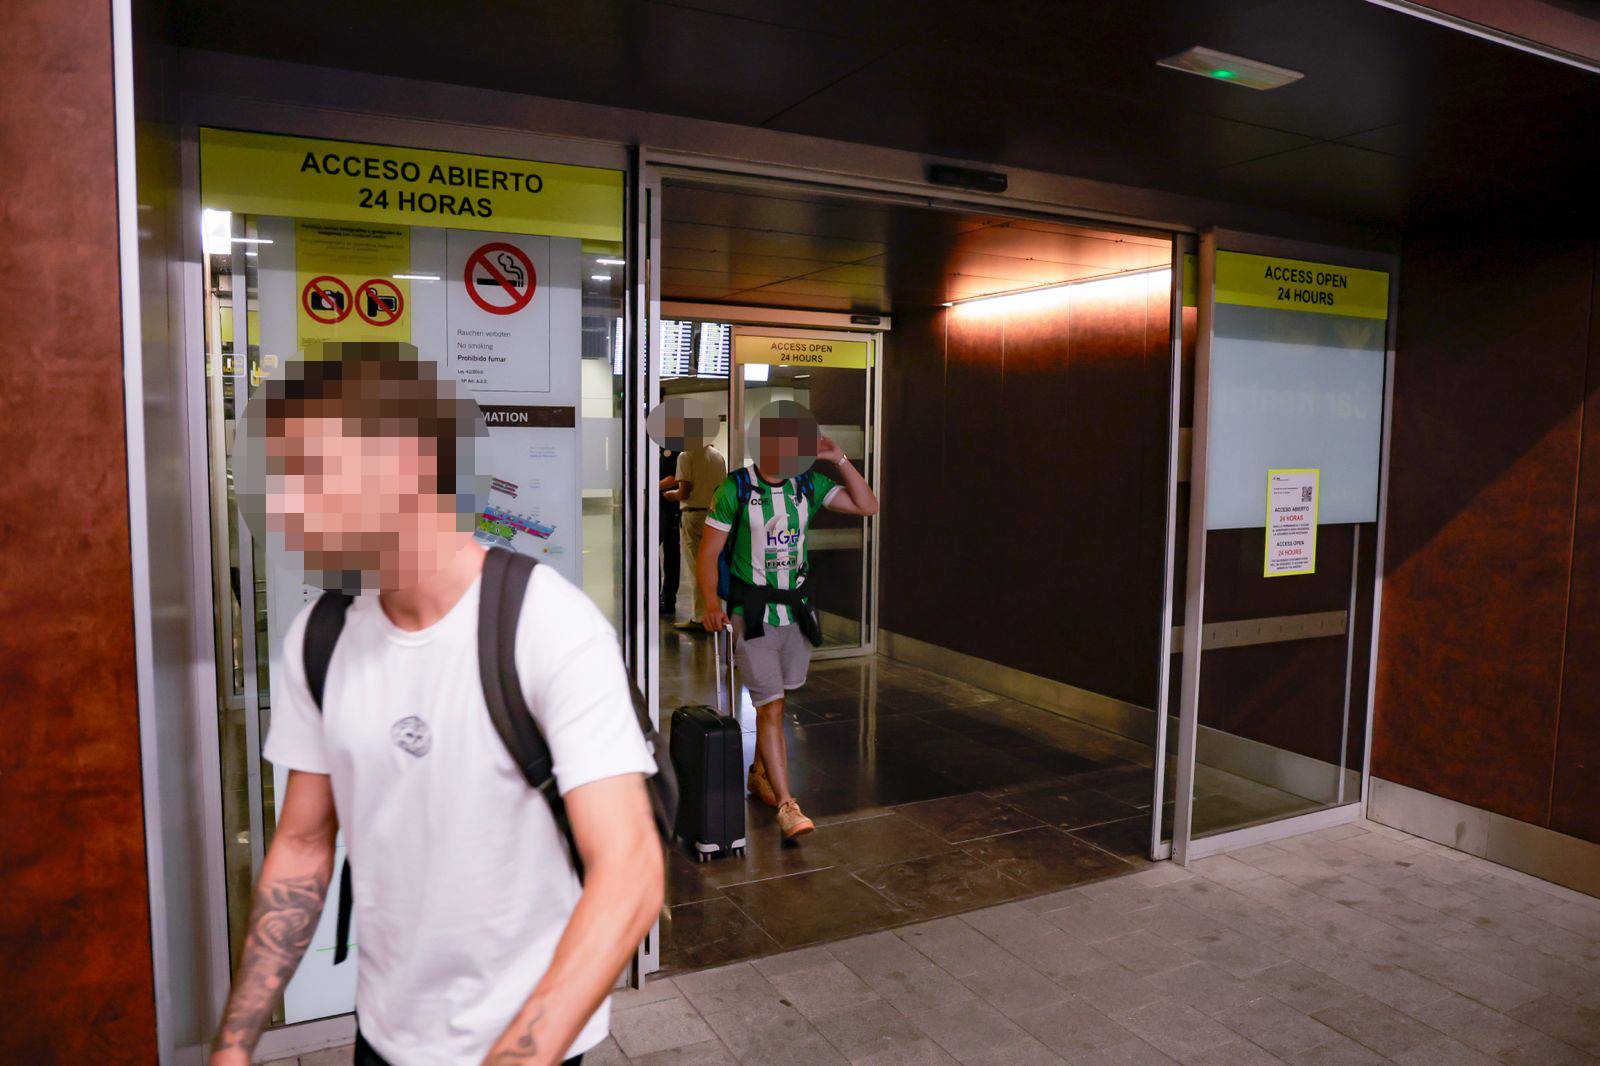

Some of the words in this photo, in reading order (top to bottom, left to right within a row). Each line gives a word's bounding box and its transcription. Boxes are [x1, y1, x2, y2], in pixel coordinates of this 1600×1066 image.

[300, 151, 421, 182] ACCESO
[428, 164, 543, 194] ABIERTO
[359, 187, 389, 210] 24
[398, 190, 493, 218] HORAS
[1264, 265, 1313, 285] ACCESS
[1316, 272, 1347, 289] OPEN
[1277, 287, 1291, 300] 24
[1294, 288, 1334, 306] HOURS
[457, 341, 466, 349] No
[467, 343, 493, 351] smoking
[771, 342, 807, 352] ACCESS
[809, 344, 833, 353] OPEN
[780, 353, 790, 361] 24
[792, 353, 823, 363] HOURS
